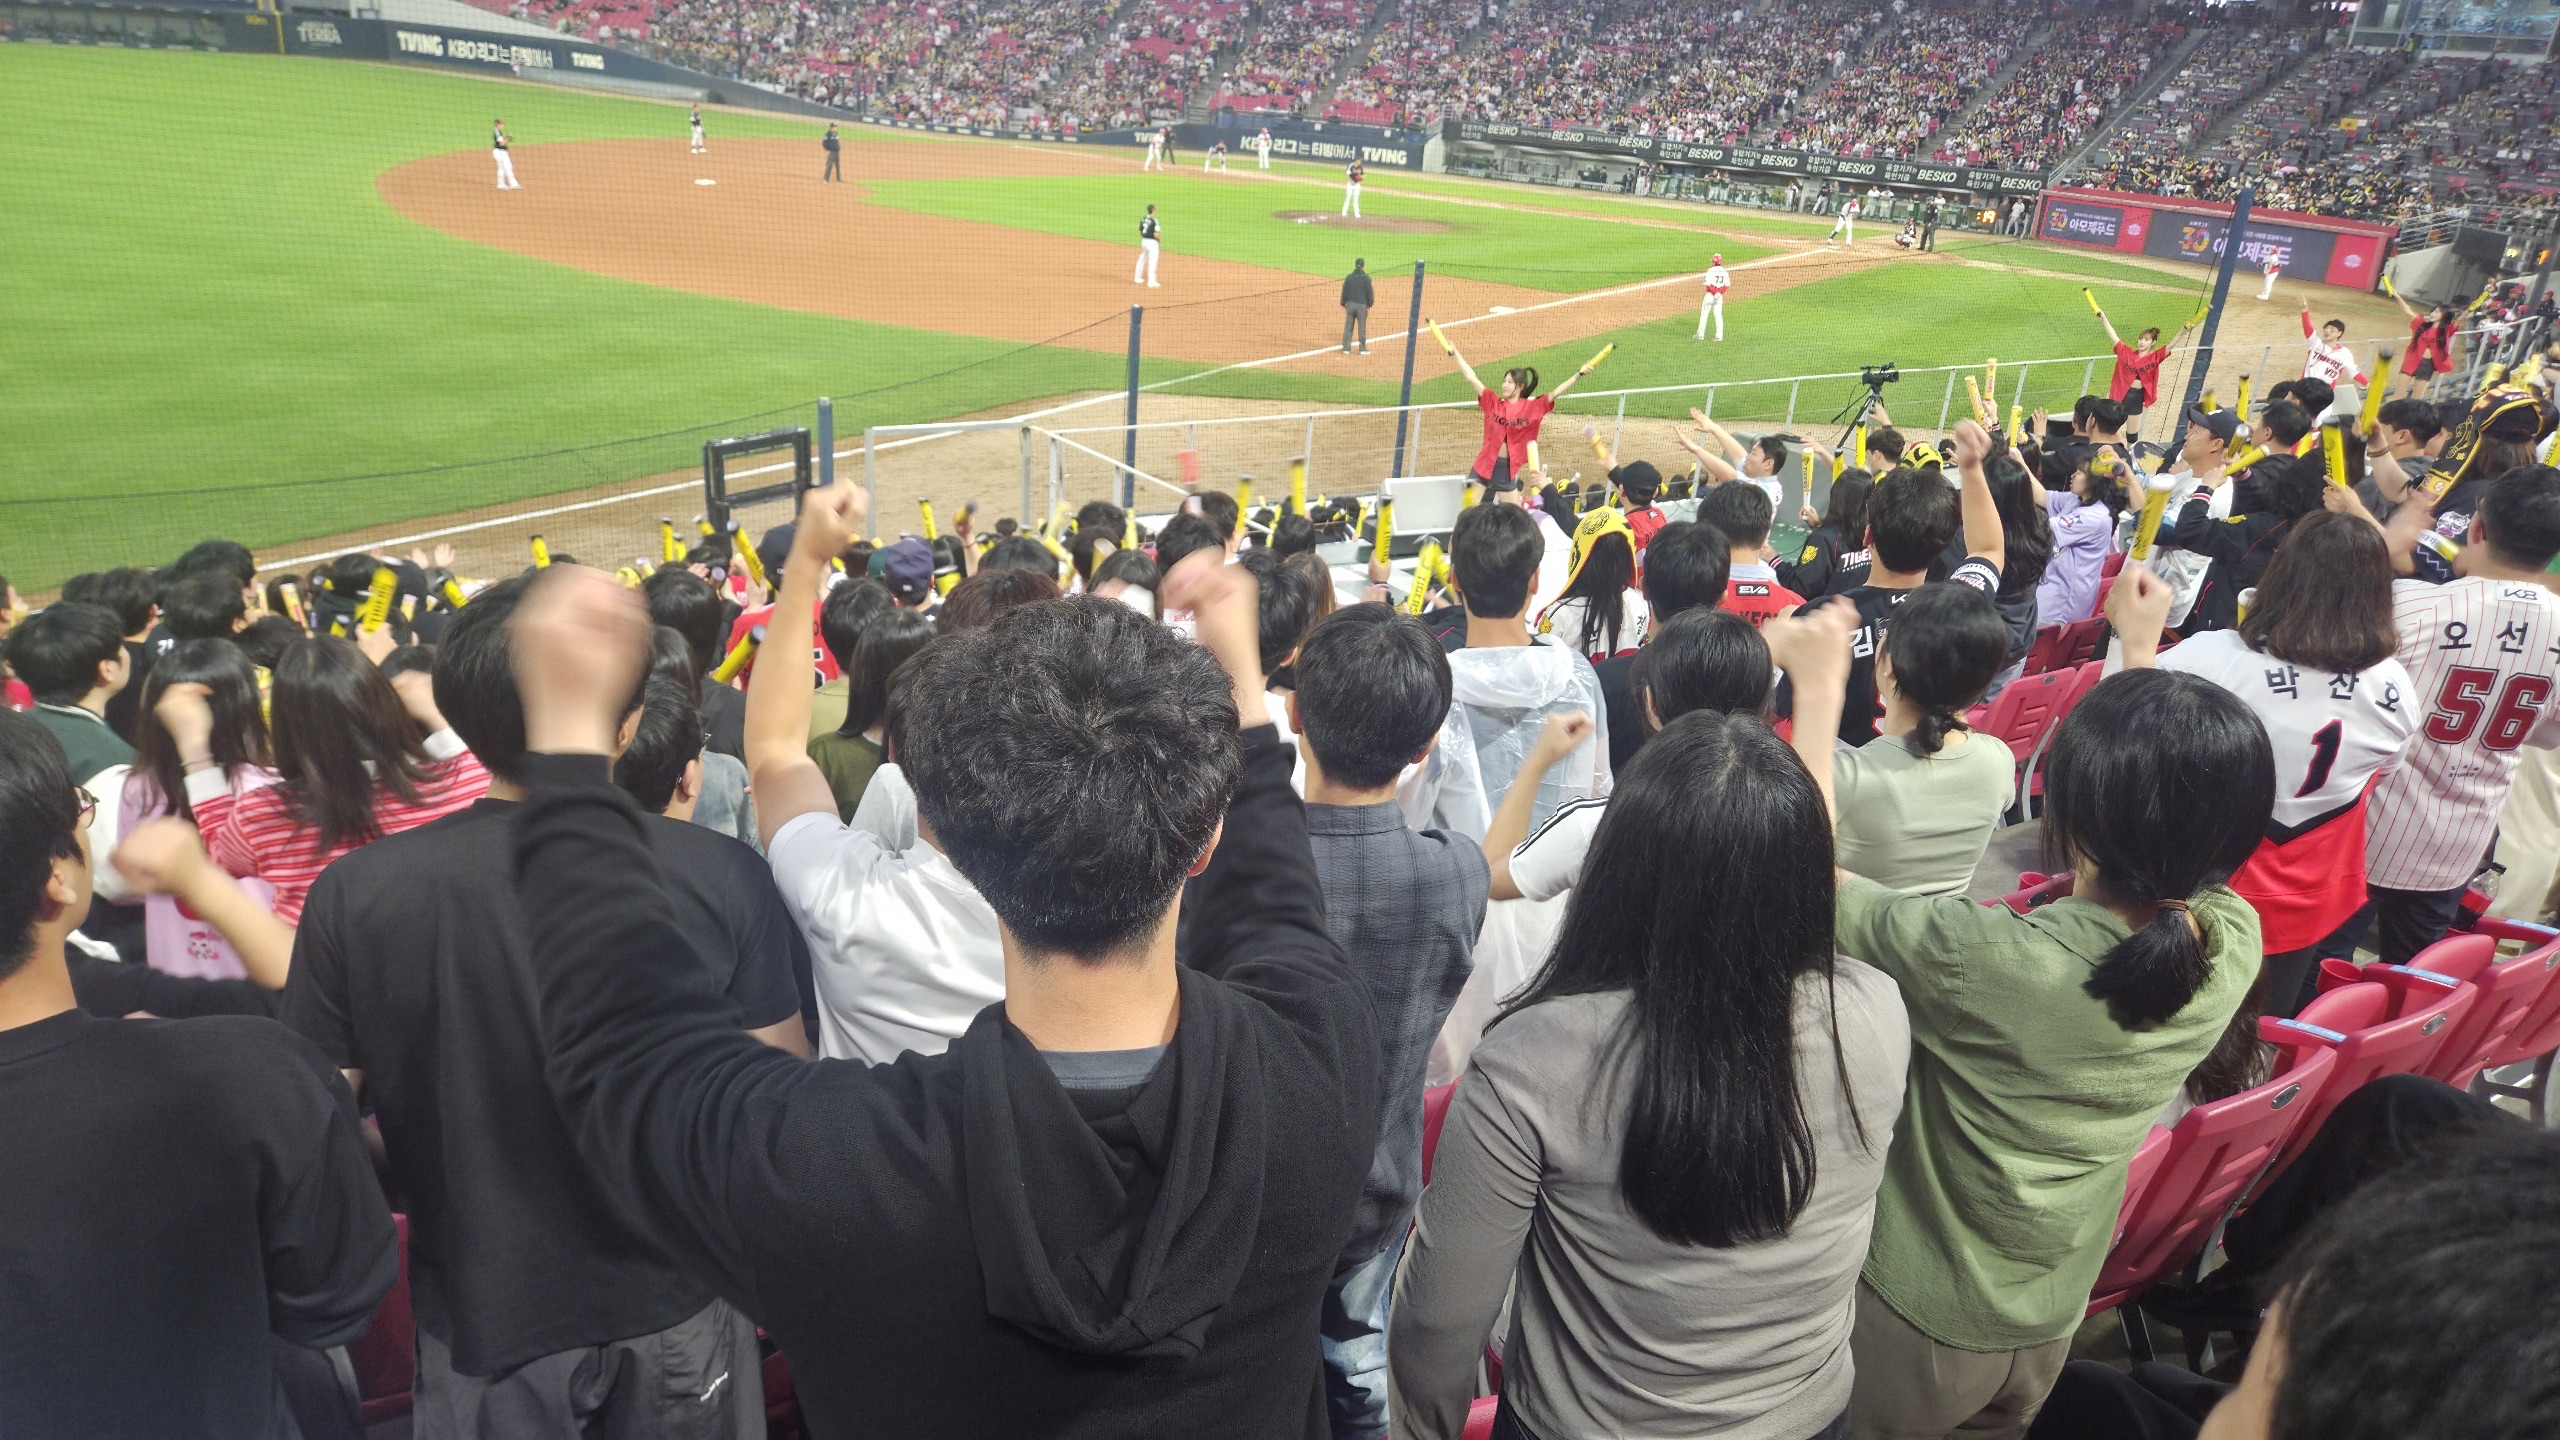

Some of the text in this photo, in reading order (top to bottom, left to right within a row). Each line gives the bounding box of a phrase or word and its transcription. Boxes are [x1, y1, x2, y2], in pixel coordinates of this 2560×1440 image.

[397, 30, 443, 56] TVING
[571, 51, 604, 70] TVING
[1487, 123, 1519, 137] BESKO
[1551, 129, 1585, 143] BESKO
[1618, 136, 1653, 149] BESKO
[1311, 142, 1356, 160] 티빙에서
[1361, 146, 1407, 165] TVING
[1687, 147, 1723, 161] BESKO
[1761, 154, 1798, 167] BESKO
[1837, 161, 1876, 175] BESKO
[1916, 169, 1957, 183] BESKO
[2000, 177, 2042, 191] BESKO
[2069, 218, 2116, 236] 아모제푸드
[2178, 226, 2210, 252] 30
[1739, 585, 1769, 594] EV6
[2423, 664, 2553, 750] 56
[2294, 719, 2342, 798] 1
